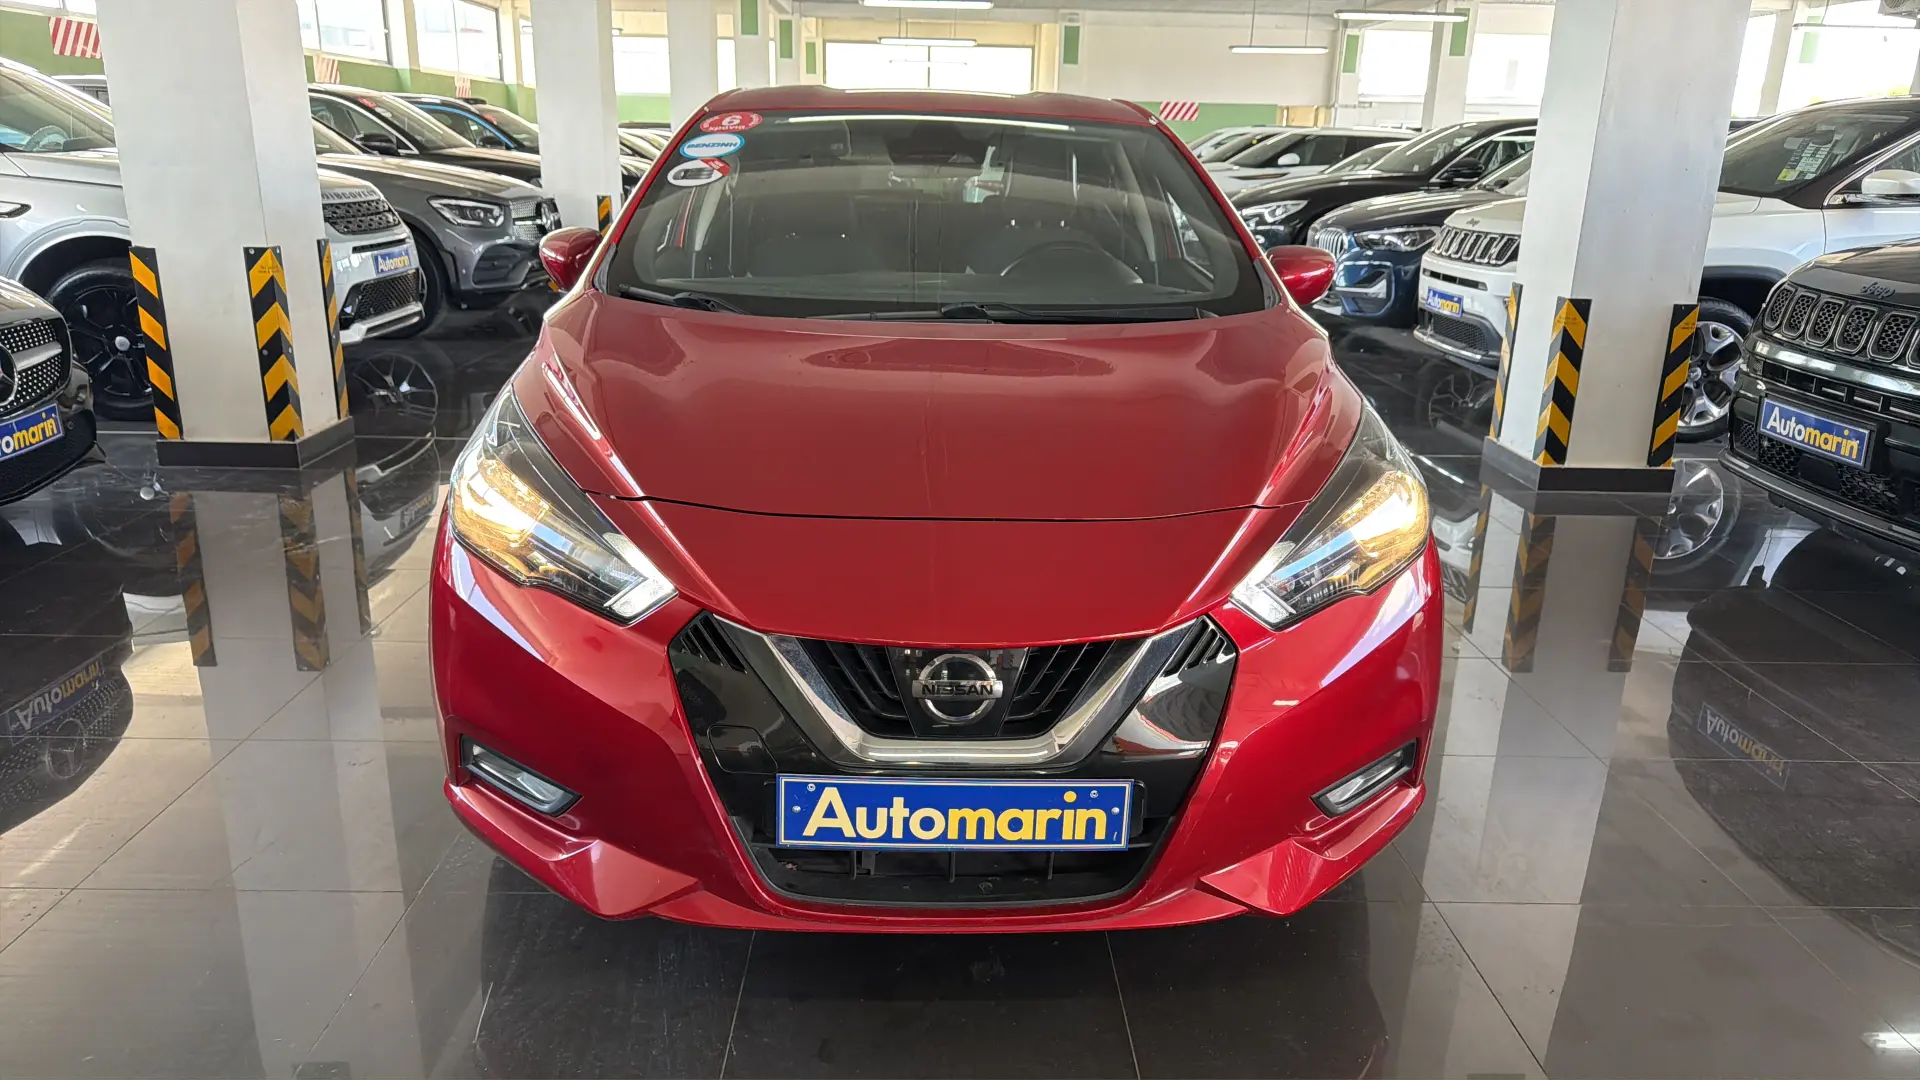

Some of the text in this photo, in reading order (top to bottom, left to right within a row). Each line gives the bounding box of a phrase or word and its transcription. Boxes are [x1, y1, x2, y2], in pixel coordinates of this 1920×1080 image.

[722, 115, 743, 126] 6
[1860, 282, 1896, 299] Jeep
[0, 412, 58, 454] omarin
[1766, 407, 1860, 459] Automarin
[922, 684, 994, 695] NISSAN
[802, 786, 1107, 841] Automarin
